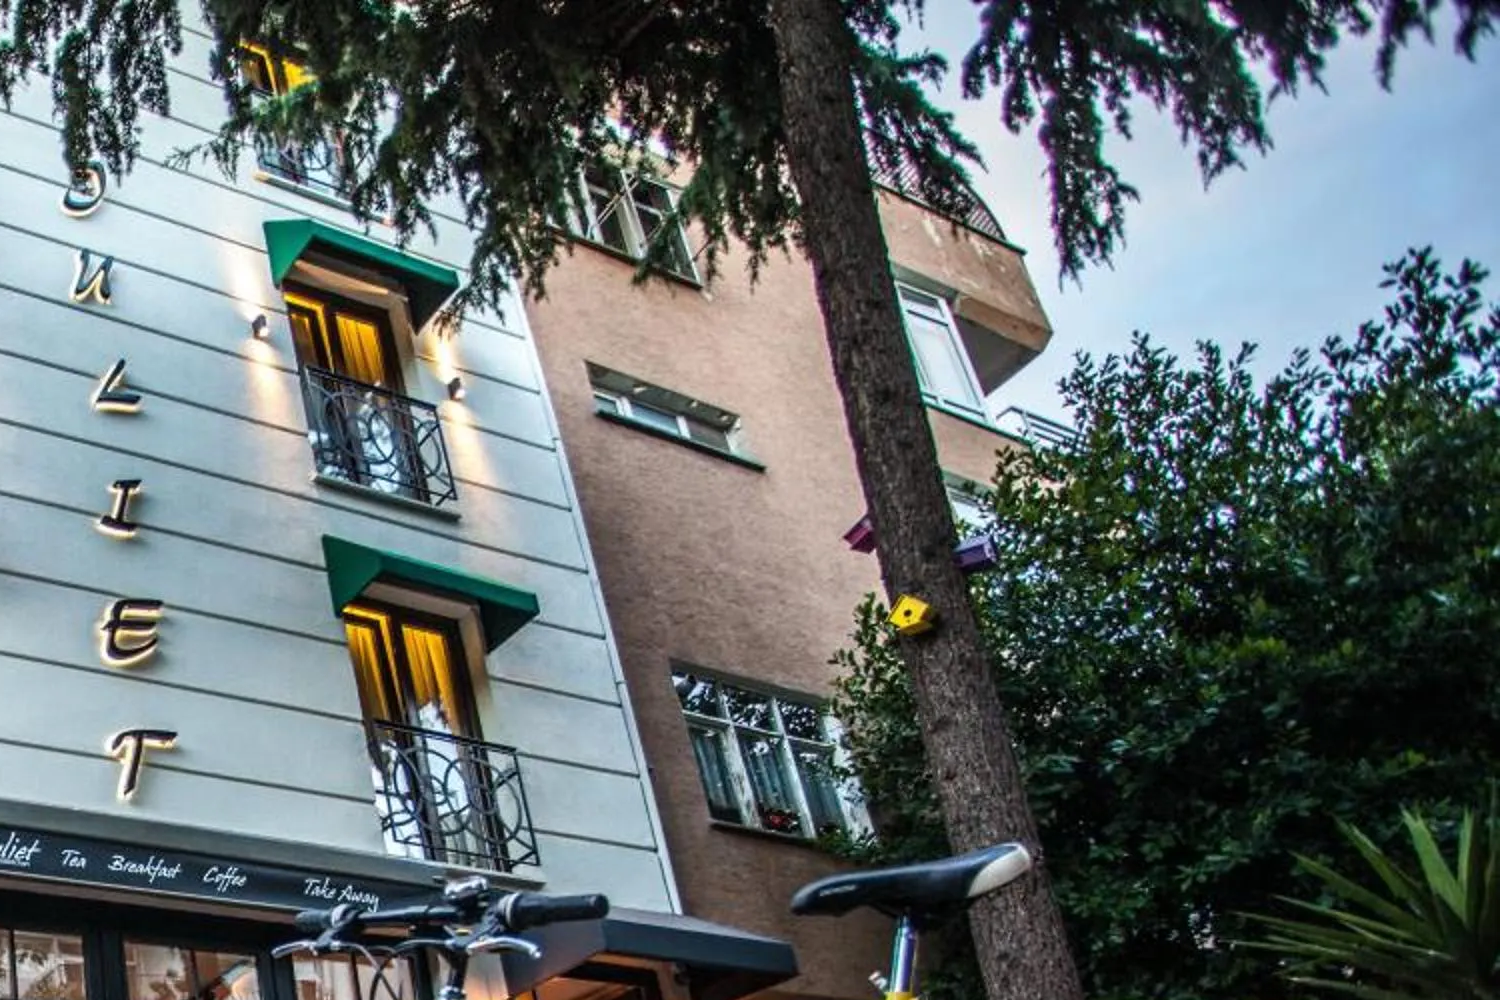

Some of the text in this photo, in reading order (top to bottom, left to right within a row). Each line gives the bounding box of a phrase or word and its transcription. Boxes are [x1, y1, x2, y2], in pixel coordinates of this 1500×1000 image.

[61, 849, 87, 869] Tea
[108, 855, 183, 883] Breakfast
[203, 866, 247, 893] Coffee
[304, 877, 337, 899] Take
[337, 885, 379, 913] Away
